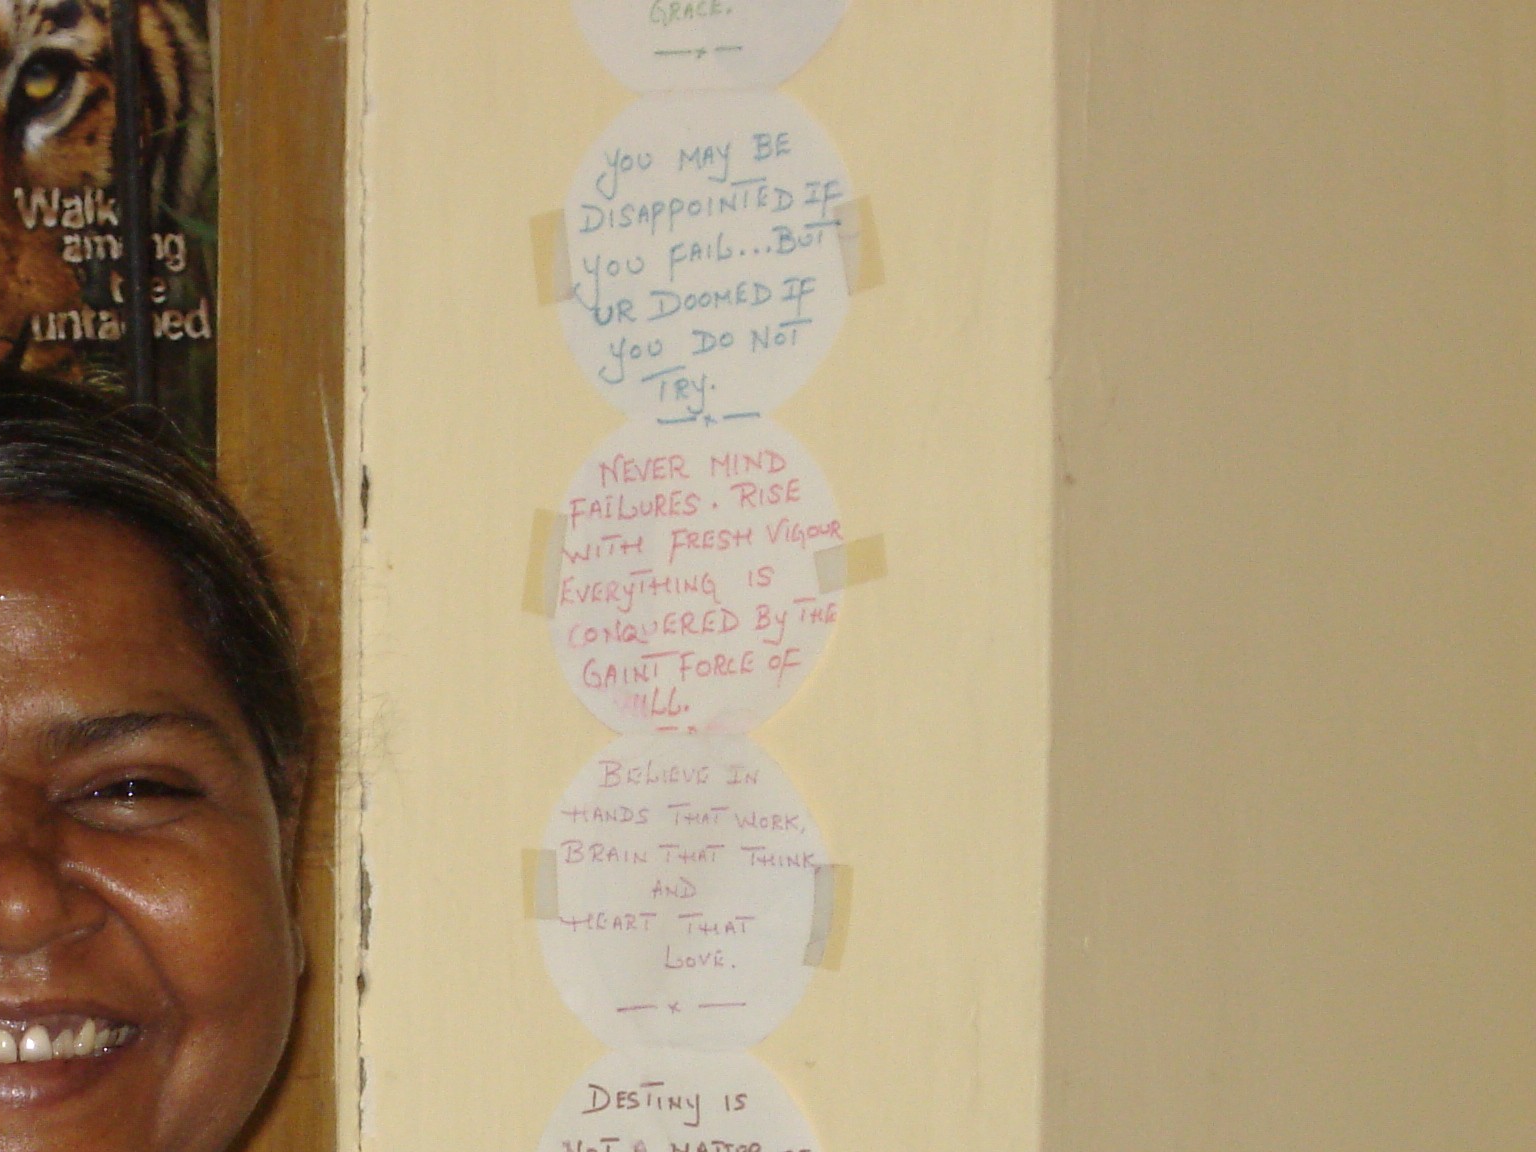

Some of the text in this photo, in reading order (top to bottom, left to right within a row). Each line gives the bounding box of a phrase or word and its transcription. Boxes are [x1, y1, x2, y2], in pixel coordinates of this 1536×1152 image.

[678, 143, 731, 183] MAY
[752, 132, 792, 162] BE
[13, 186, 121, 230] Walk
[579, 178, 844, 236] DISAPPOINTED IF
[592, 277, 817, 327] UR DOOMED IF
[691, 329, 735, 357] DO
[751, 319, 813, 354] NOT
[598, 449, 788, 489] NEVER MIND
[729, 479, 802, 510] RISE
[559, 517, 845, 565] WITH FRESH VIGOUR
[559, 566, 776, 615] EVERYTHING IS
[567, 596, 838, 650] CONQUERED BY THE
[678, 647, 802, 689] FORCE OF
[597, 760, 761, 789] BELIEVE IN
[559, 805, 651, 826] HANDS
[666, 801, 730, 826] THAT
[559, 838, 726, 865] BRAIN THAT
[651, 876, 698, 899] AND
[558, 910, 756, 936] HEART THAT
[663, 944, 737, 970] LOVE.
[580, 1080, 749, 1128] DESTINY IS
